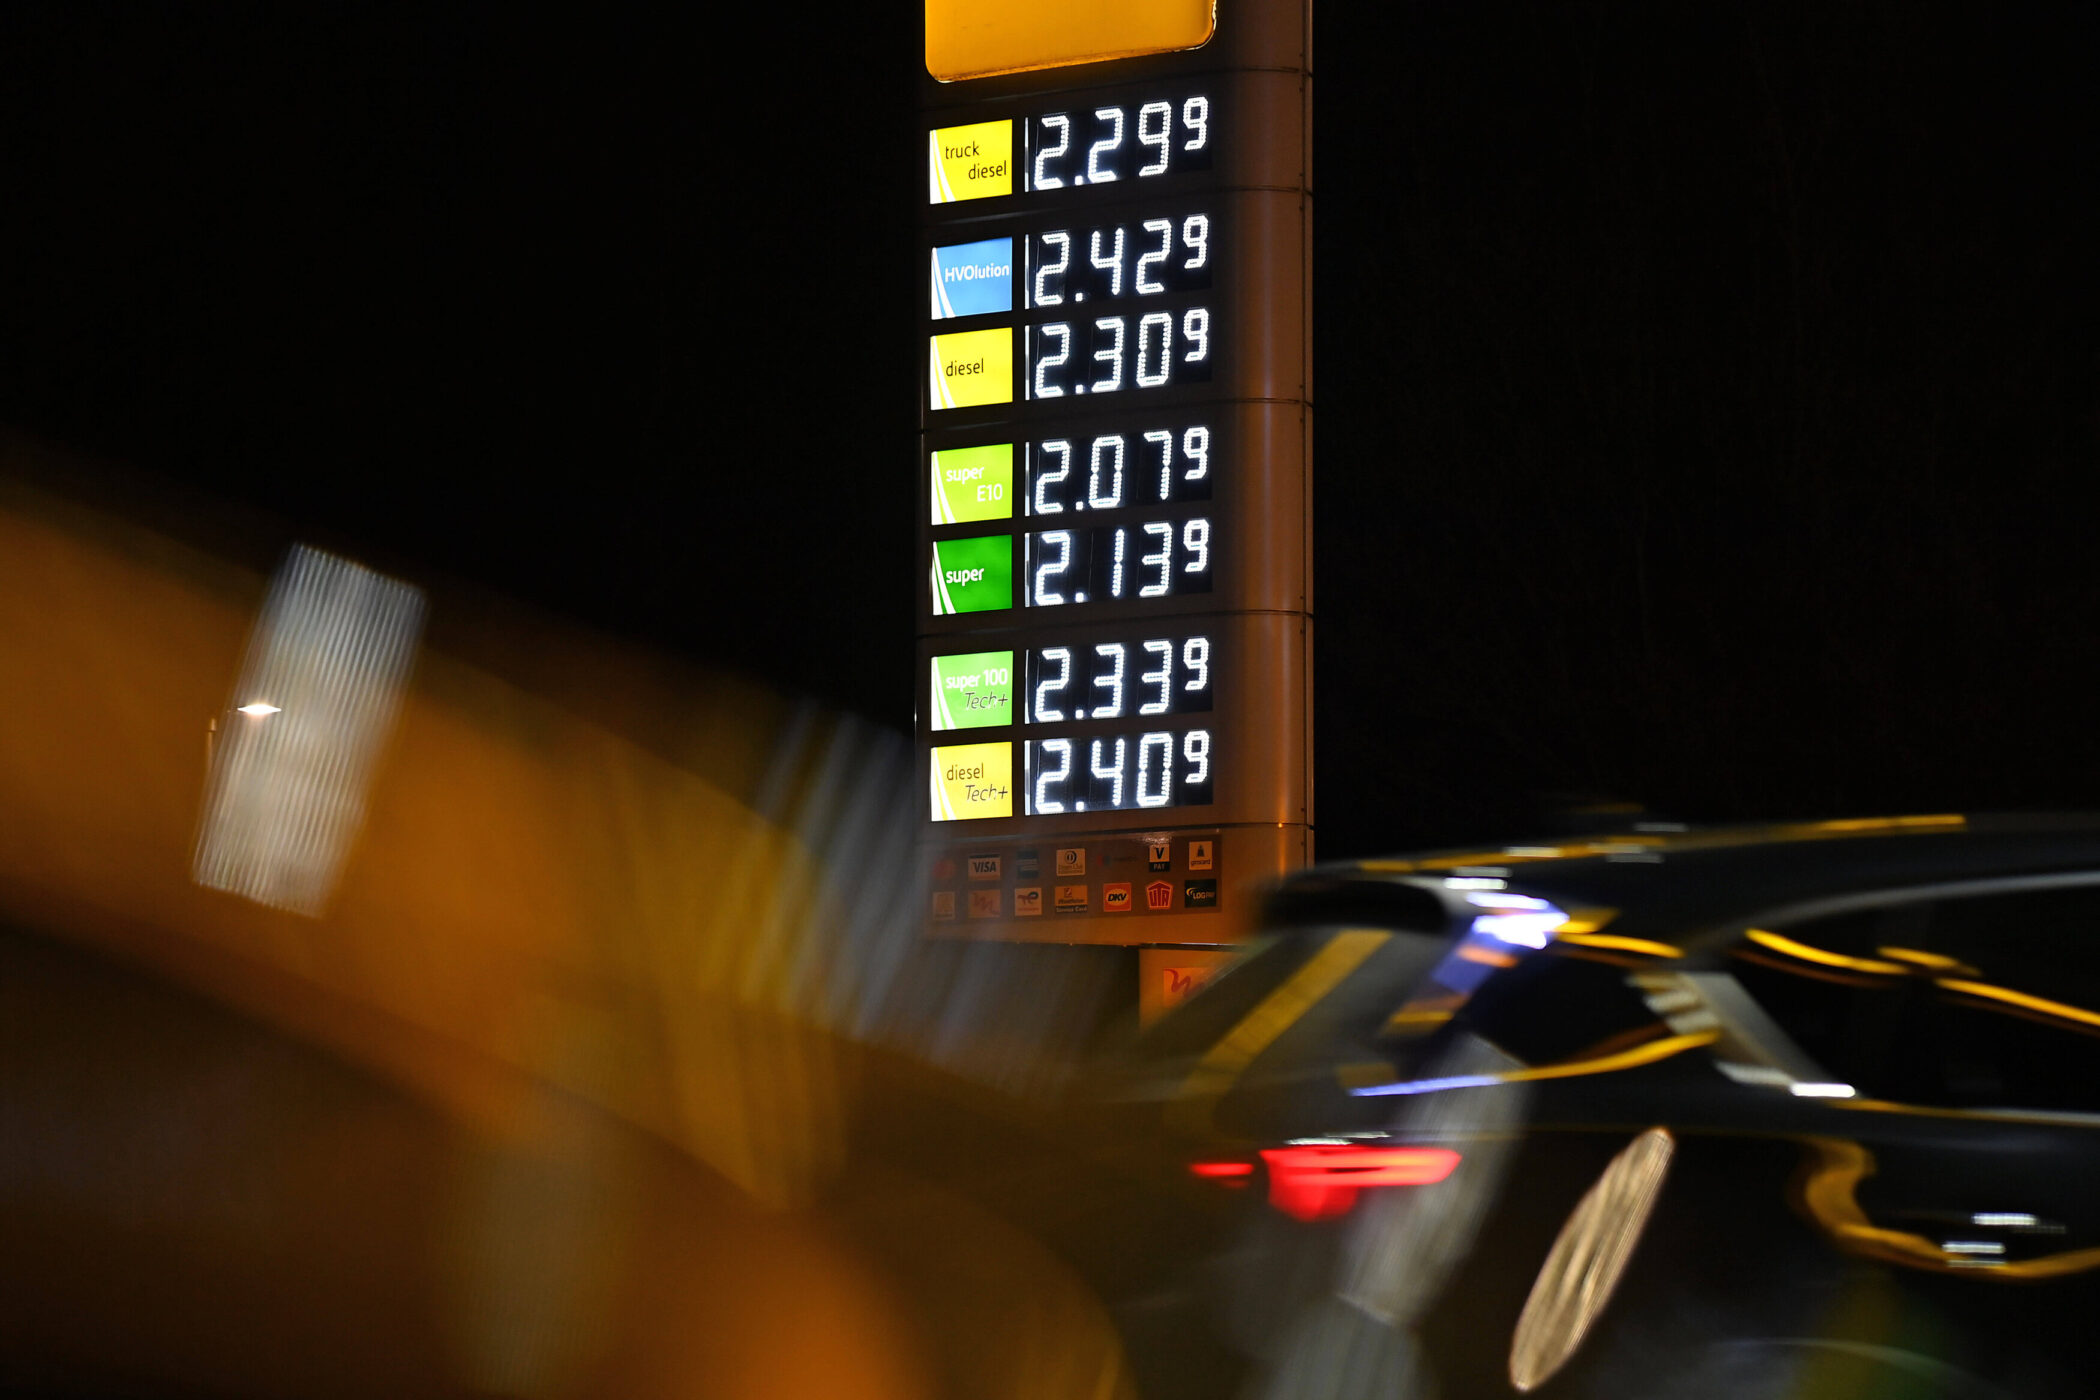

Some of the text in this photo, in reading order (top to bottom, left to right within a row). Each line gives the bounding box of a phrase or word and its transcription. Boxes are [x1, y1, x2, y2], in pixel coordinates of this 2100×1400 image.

[945, 141, 980, 160] truck
[968, 160, 1007, 180] diesel
[944, 263, 1010, 283] HVOlution
[945, 358, 984, 377] diesel
[945, 466, 985, 485] super
[976, 483, 1003, 502] E10
[945, 567, 985, 586] super
[945, 668, 1008, 692] super 100
[964, 691, 1008, 711] Tech+
[946, 762, 984, 781] diesel
[964, 783, 1008, 802] Tech+
[1155, 847, 1165, 860] V
[973, 861, 997, 873] VISA
[1108, 892, 1127, 902] DKV
